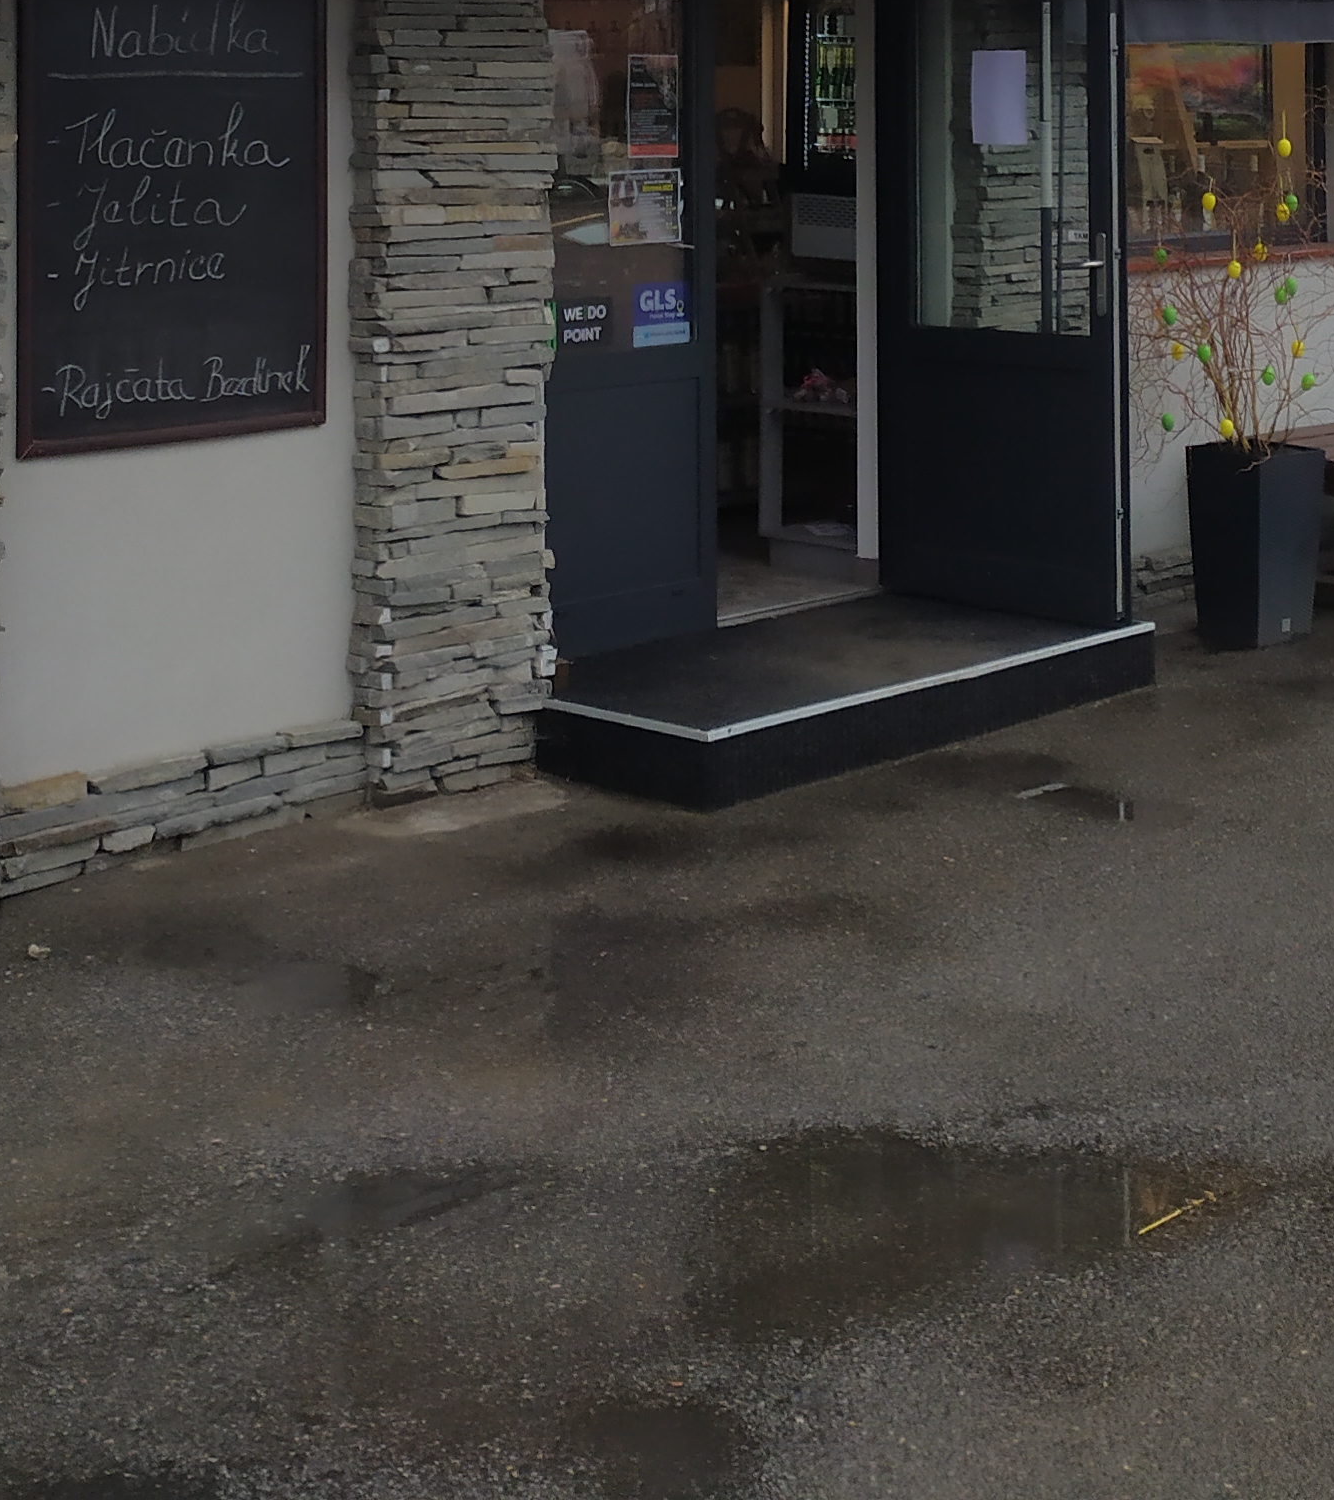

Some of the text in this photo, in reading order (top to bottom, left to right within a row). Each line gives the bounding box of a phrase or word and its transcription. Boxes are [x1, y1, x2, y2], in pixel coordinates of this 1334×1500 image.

[64, 101, 292, 170] Tlačenka
[74, 174, 247, 250] Jelita
[74, 247, 227, 312] Jitrnice
[639, 288, 677, 312] GLS
[563, 304, 607, 322] WE DO
[563, 326, 602, 343] POINT
